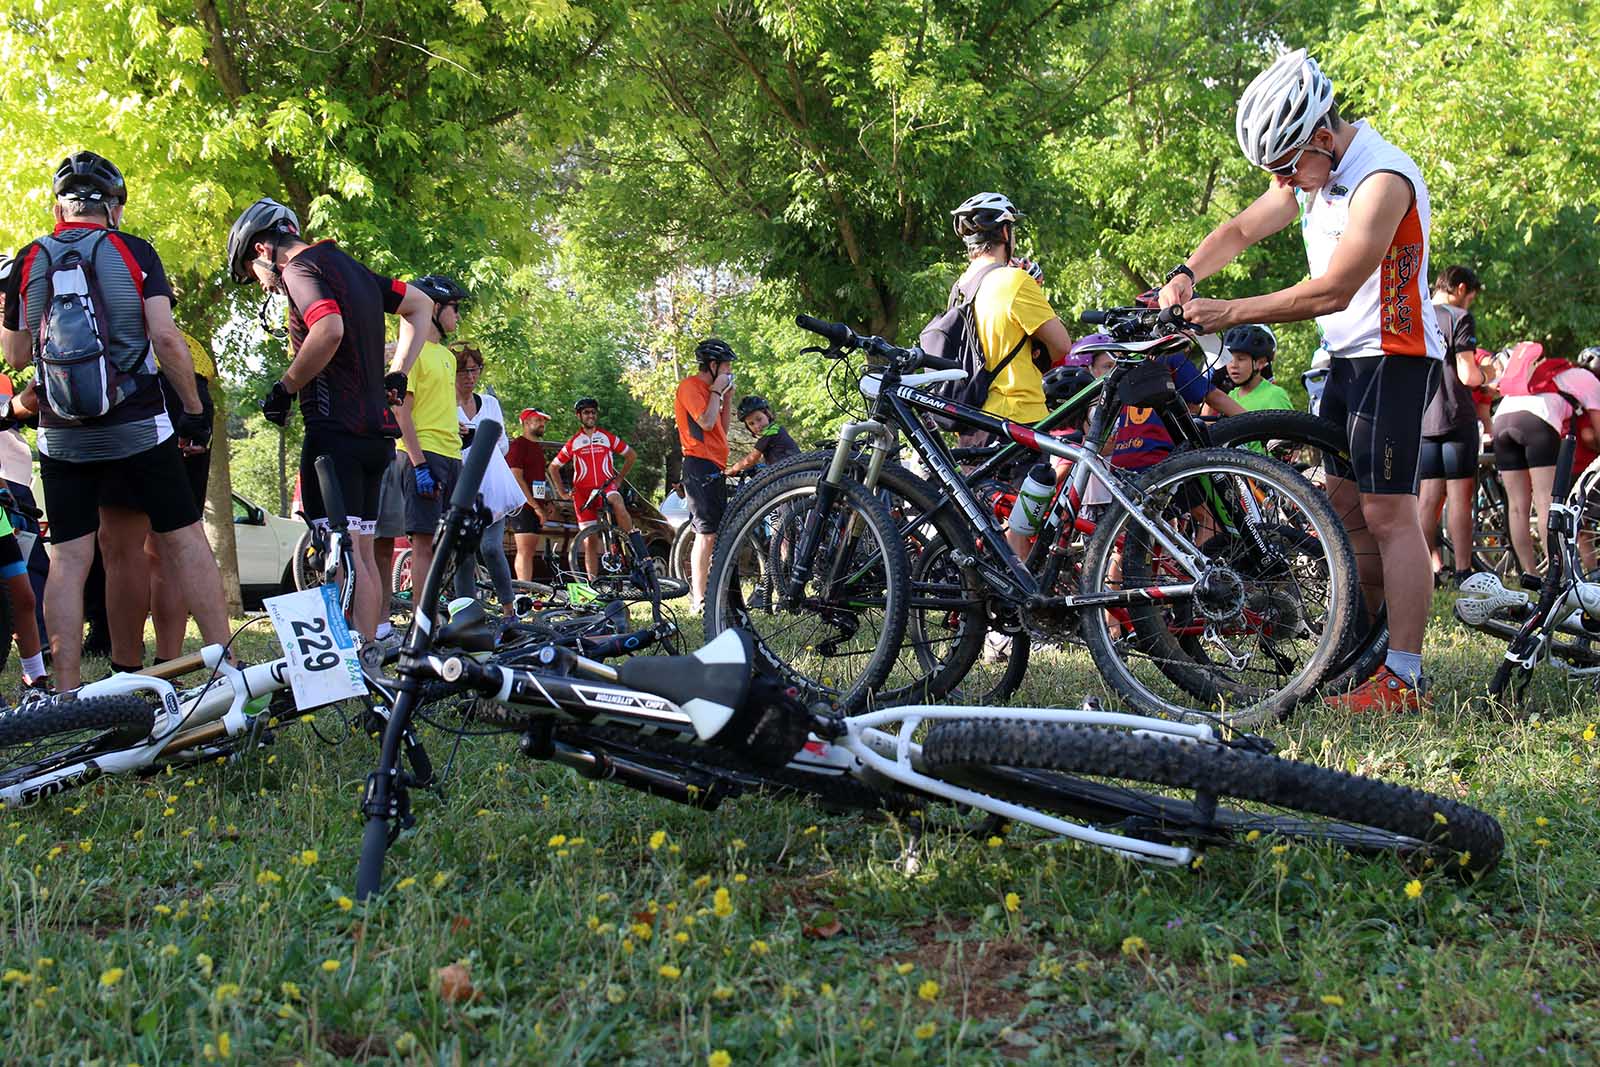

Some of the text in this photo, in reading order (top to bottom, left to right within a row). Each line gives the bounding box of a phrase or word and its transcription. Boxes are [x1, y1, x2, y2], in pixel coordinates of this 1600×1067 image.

[914, 393, 946, 410] TEAM
[911, 427, 988, 532] PROGRESS
[291, 617, 340, 672] 229
[594, 693, 635, 705] ATTENTION
